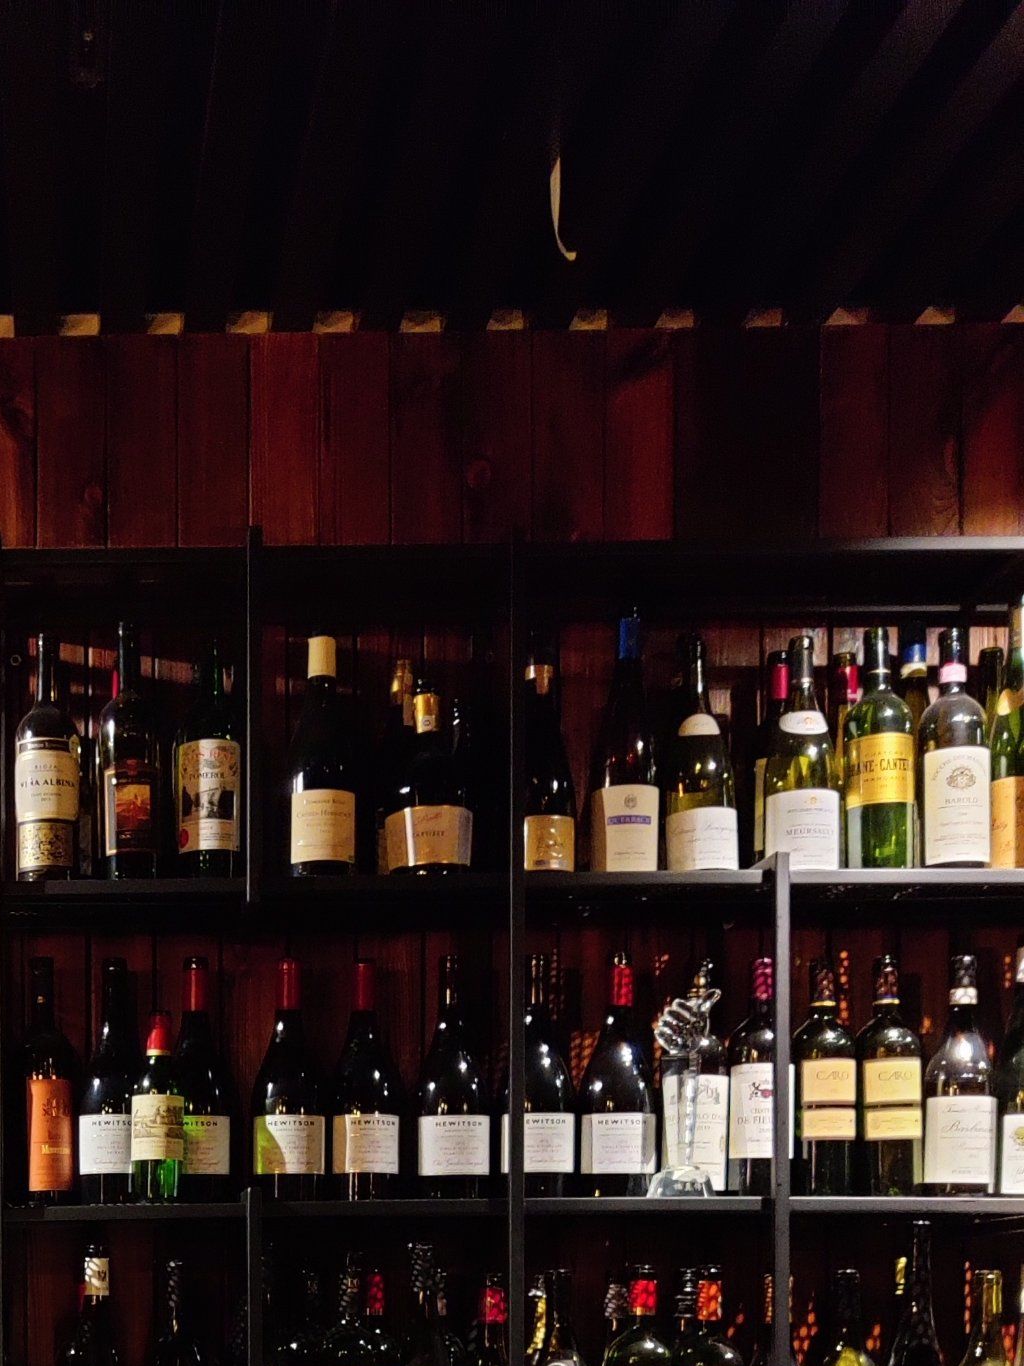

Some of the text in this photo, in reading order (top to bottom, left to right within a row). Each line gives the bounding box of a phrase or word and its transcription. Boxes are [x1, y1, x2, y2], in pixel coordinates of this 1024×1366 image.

[945, 797, 978, 805] BAROLO
[815, 1070, 849, 1081] CARO
[878, 1069, 913, 1081] CARO
[266, 1119, 315, 1127] HEWITSON
[350, 1119, 396, 1127] HEWITSON
[435, 1120, 483, 1128] HEWITSON
[596, 1118, 648, 1126] HEWITSON
